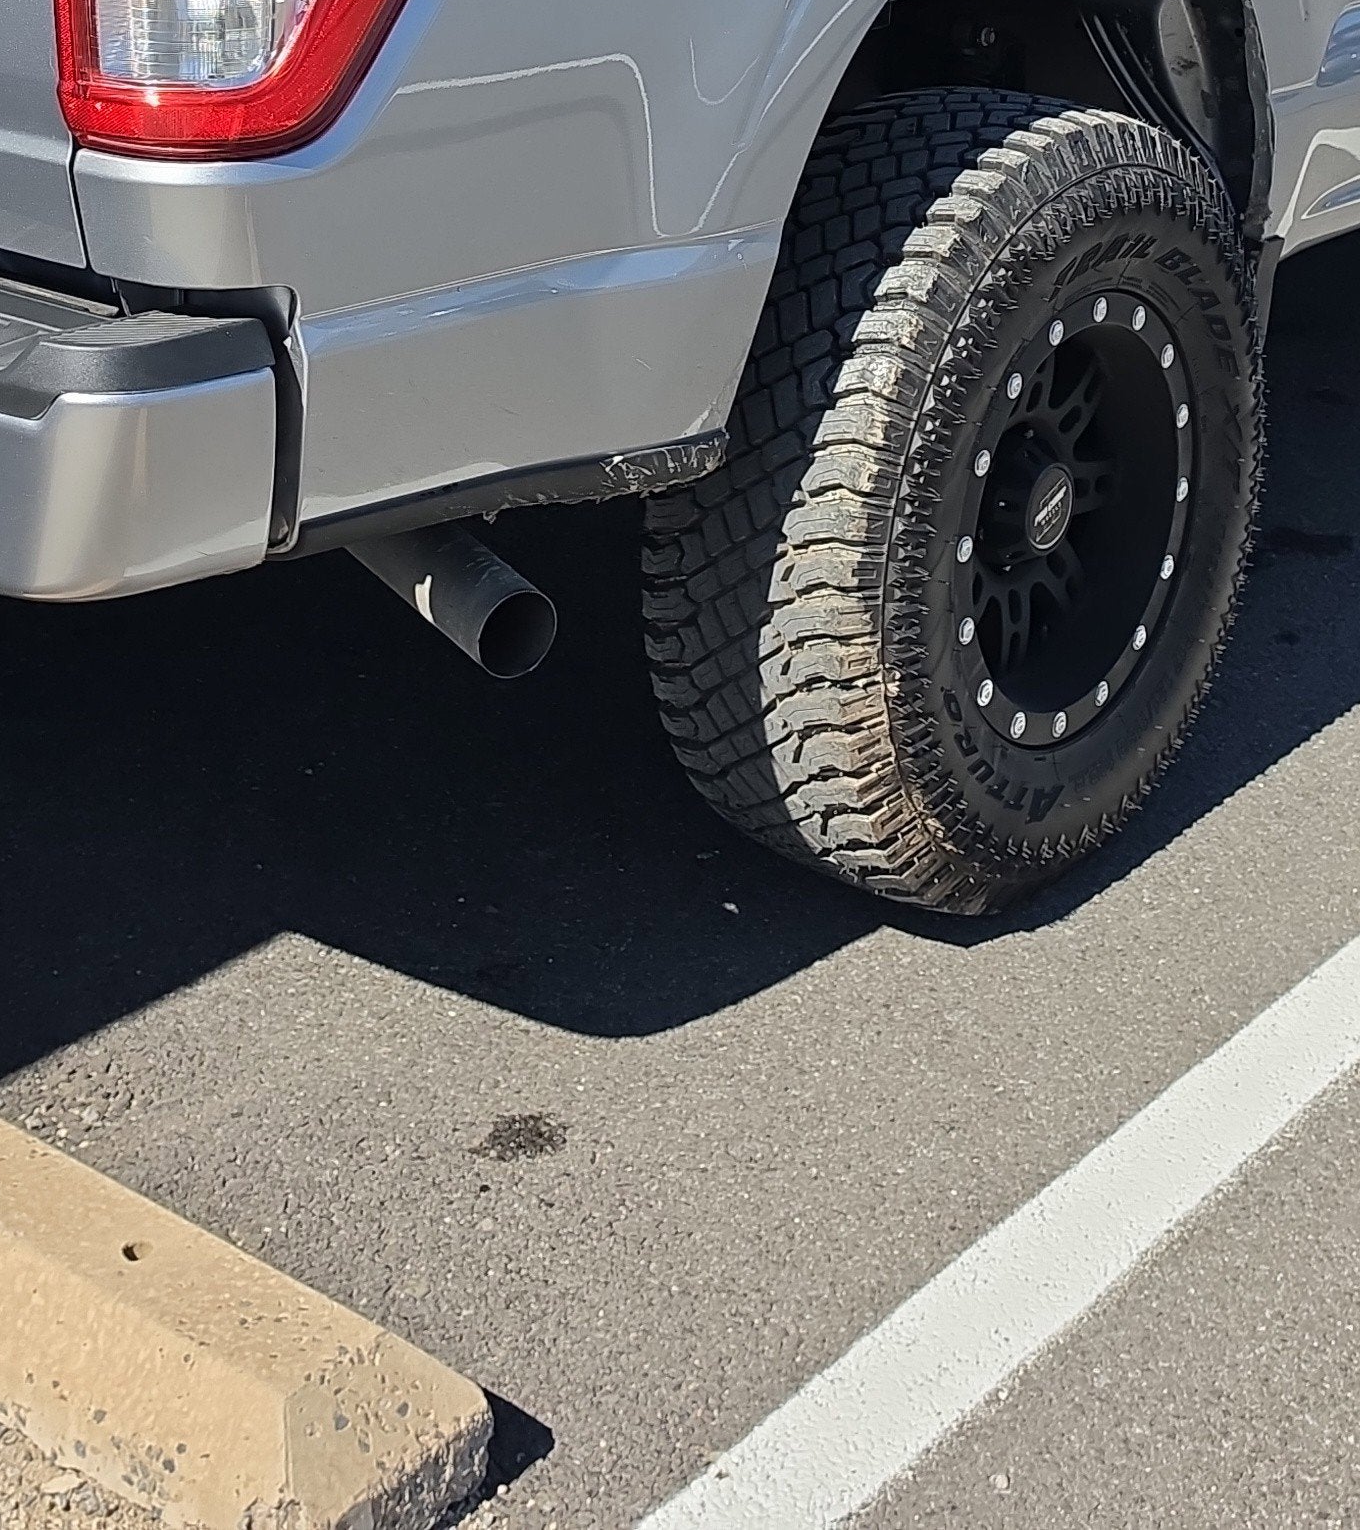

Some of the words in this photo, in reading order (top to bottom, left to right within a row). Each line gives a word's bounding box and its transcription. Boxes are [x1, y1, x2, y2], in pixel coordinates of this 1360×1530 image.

[1048, 232, 1158, 303] TRAIL
[1154, 246, 1241, 373] BLADE
[942, 689, 1066, 824] ATTURO
